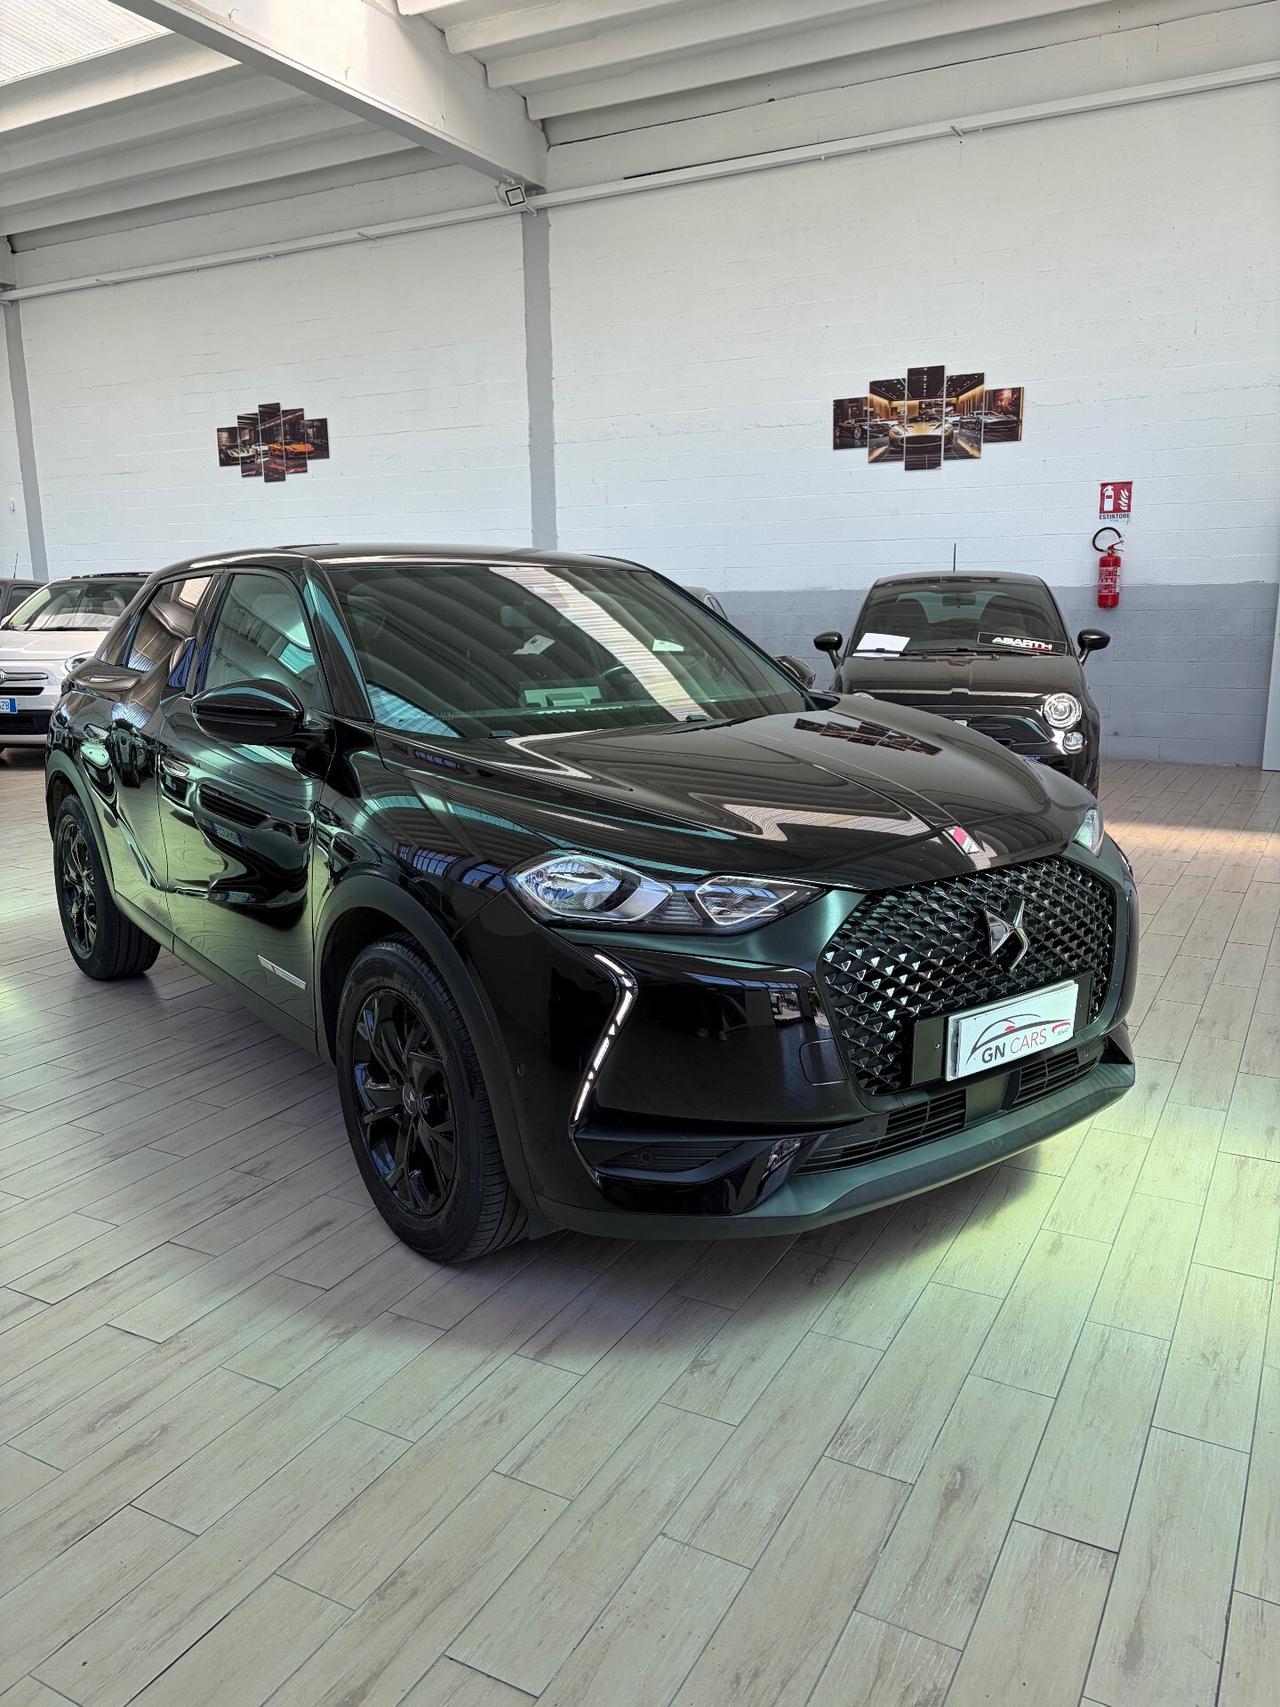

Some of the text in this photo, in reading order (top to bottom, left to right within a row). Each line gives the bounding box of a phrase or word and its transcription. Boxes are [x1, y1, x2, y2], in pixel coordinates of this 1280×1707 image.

[992, 637, 1053, 650] ABARTH
[982, 1042, 1006, 1063] GN
[1010, 1028, 1047, 1053] CARS
